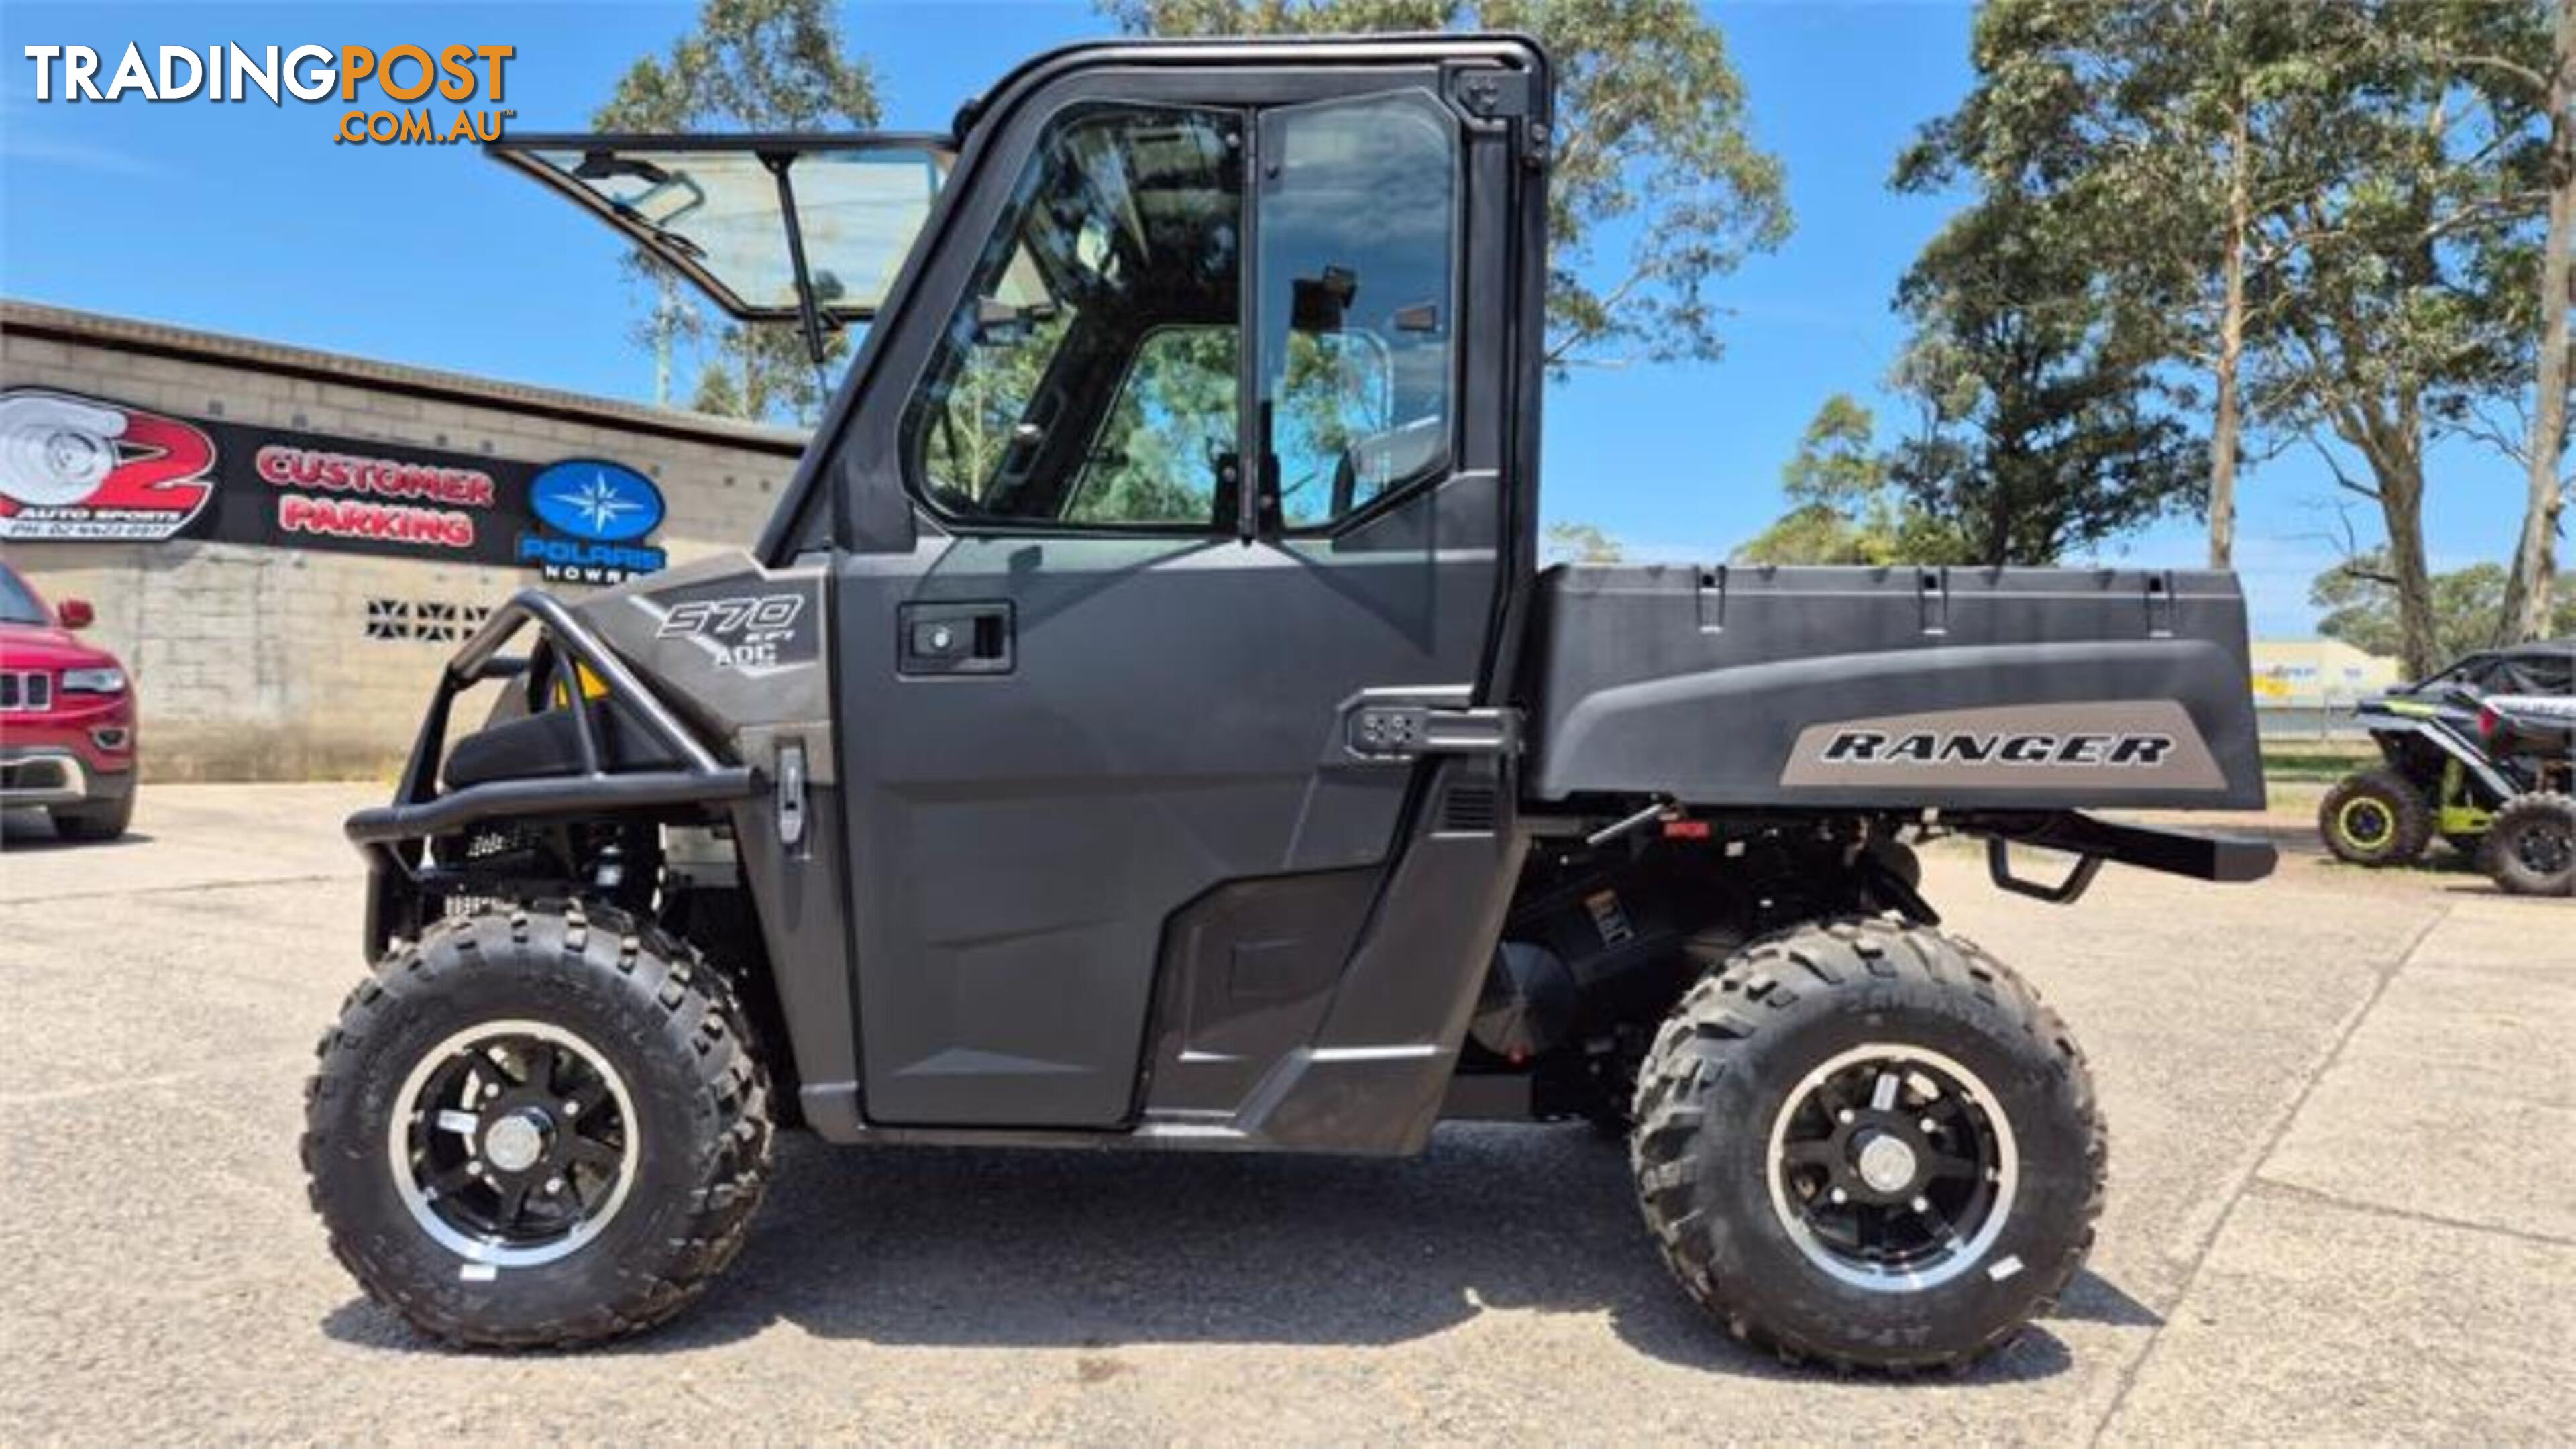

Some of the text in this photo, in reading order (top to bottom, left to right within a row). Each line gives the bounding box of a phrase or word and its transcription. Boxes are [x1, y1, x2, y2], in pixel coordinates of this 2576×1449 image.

[257, 446, 495, 504] CUSTOMER
[15, 507, 181, 523] AUTO SPORTS
[280, 494, 472, 547] PARKING
[519, 534, 665, 573] POLARIS
[656, 594, 804, 639] 570
[1822, 731, 2174, 767] RANGER
